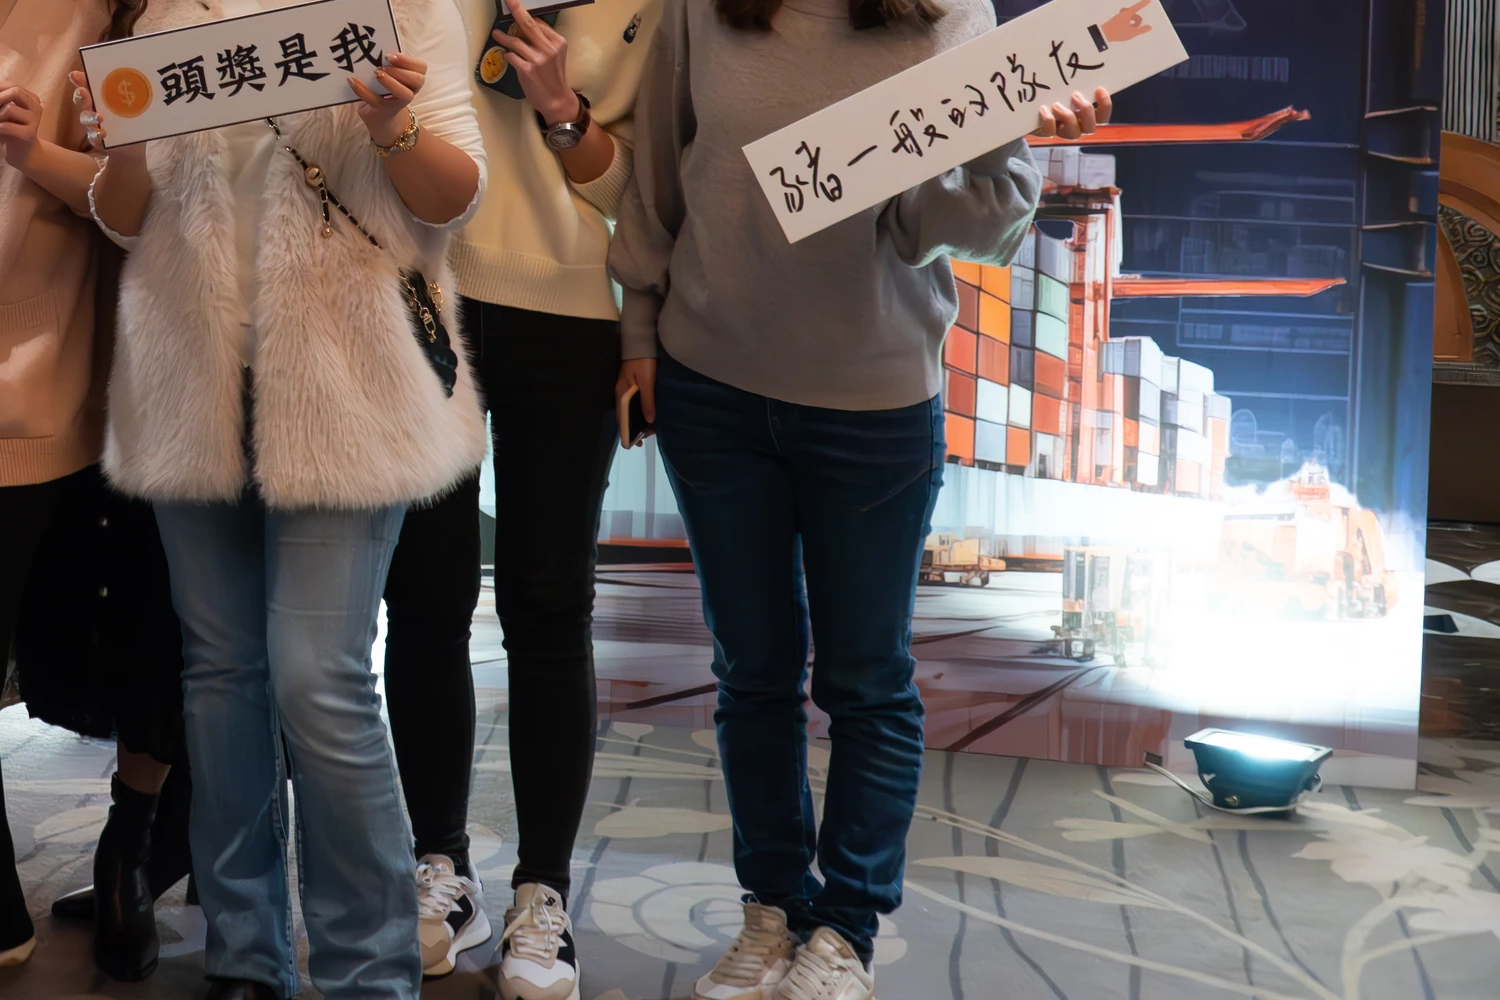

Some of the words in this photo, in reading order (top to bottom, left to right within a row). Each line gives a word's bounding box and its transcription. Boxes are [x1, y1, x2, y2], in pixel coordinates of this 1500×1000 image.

[156, 22, 383, 106] 頭獎是我
[769, 40, 1105, 213] 豬一般的隊友
